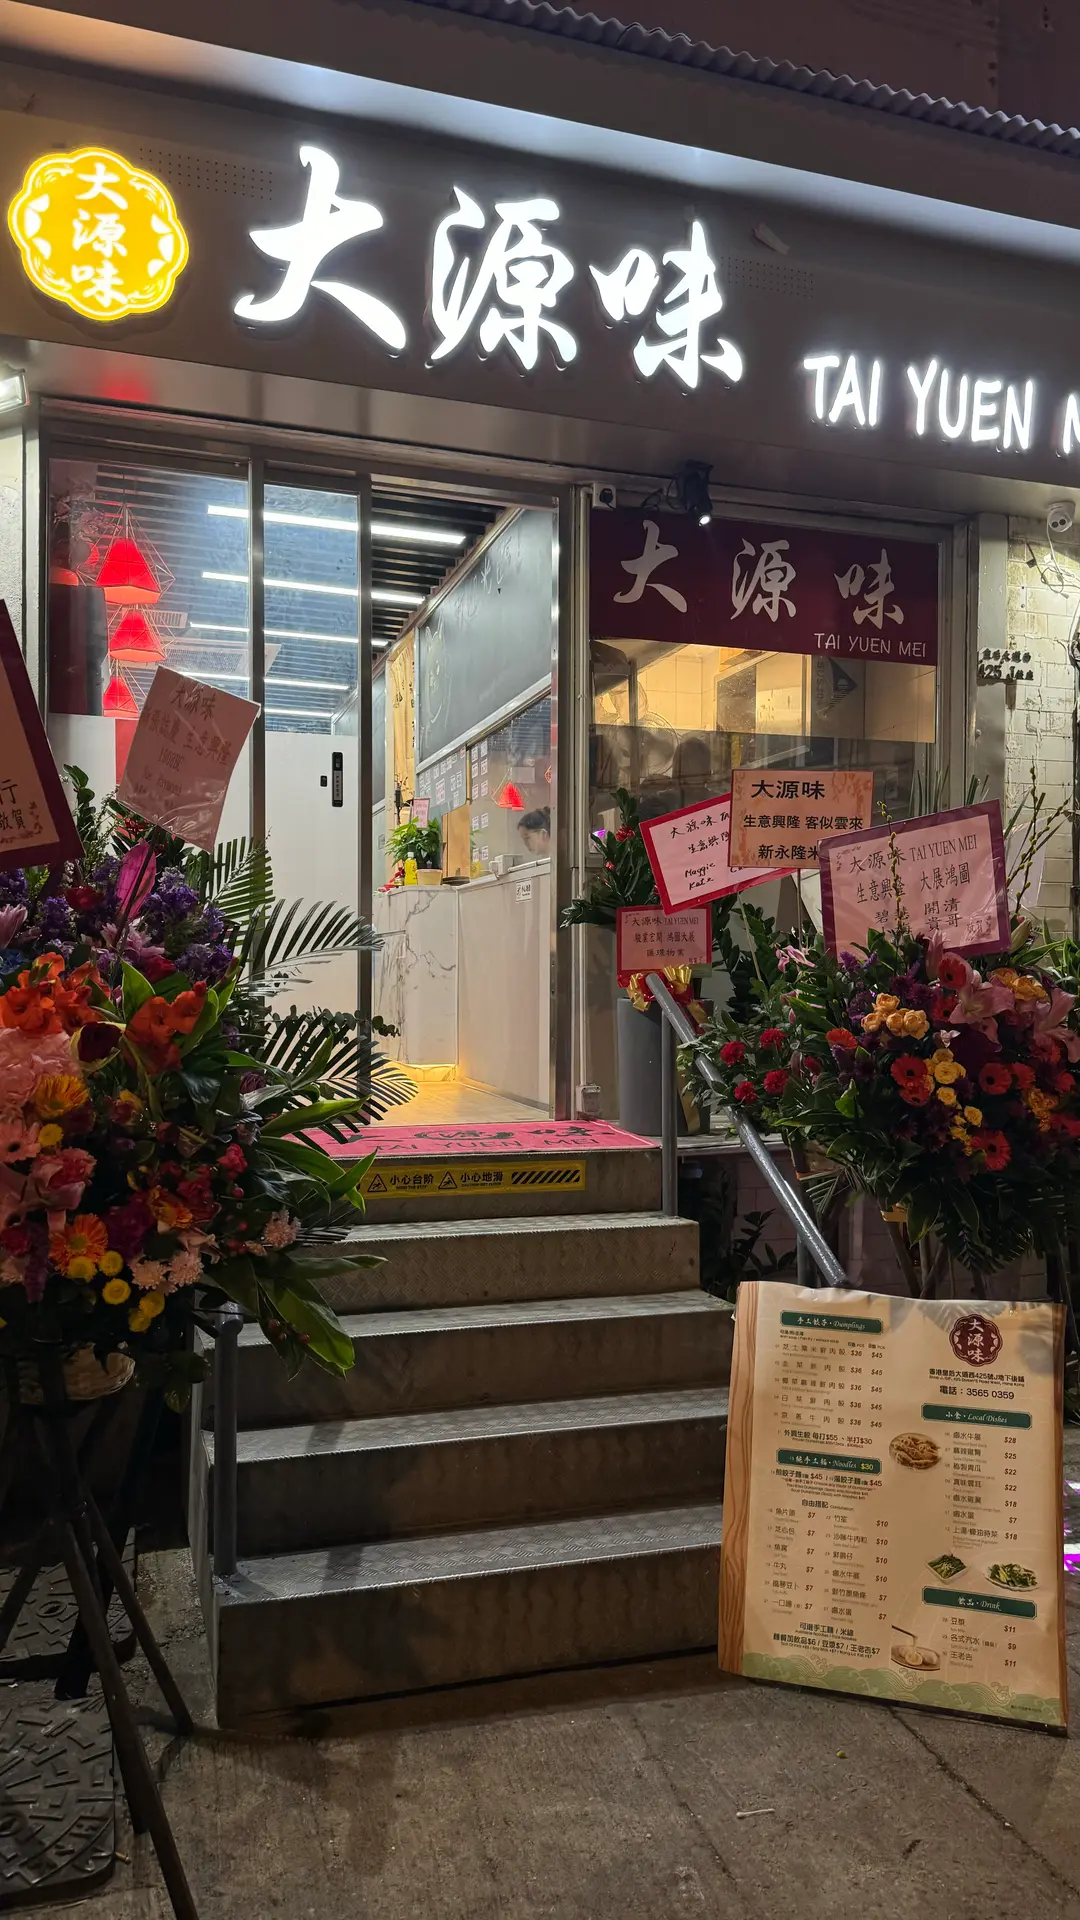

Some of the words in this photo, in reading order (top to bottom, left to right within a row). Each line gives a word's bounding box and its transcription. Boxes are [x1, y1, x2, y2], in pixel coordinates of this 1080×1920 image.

[72, 163, 128, 306] 大源味
[233, 145, 743, 389] 大源味
[803, 356, 881, 427] TAI
[906, 359, 1034, 450] YUEN
[613, 520, 904, 629] 大源味
[814, 633, 840, 649] TAI
[849, 636, 890, 653] YUEN
[899, 641, 926, 657] MEI
[751, 780, 825, 800] 大源味
[670, 815, 718, 839] 大源味
[743, 815, 800, 829] 生意興隆
[805, 816, 863, 830] 客似雲來
[849, 847, 906, 874] 大源味
[909, 847, 927, 862] TAI
[927, 841, 957, 859] YUEN
[958, 835, 977, 851] MEI
[685, 863, 715, 878] Maggie
[920, 862, 970, 892] 大展鴻圖
[632, 916, 662, 926] 大源味
[439, 1140, 523, 1149] YUEN
[543, 1138, 600, 1146] MEI
[390, 1173, 434, 1186] 小心台阶
[460, 1171, 503, 1183] 小心地滑
[833, 1320, 866, 1330] Dumplings
[968, 1319, 984, 1362] 大源味
[966, 1388, 989, 1398] 3565
[991, 1390, 1014, 1400] 0359
[967, 1413, 986, 1421] Local
[986, 1415, 1008, 1423] Dishes
[1004, 1436, 1017, 1444] $28
[1004, 1452, 1017, 1460] $25
[833, 1460, 857, 1469] Noodles
[980, 1600, 1002, 1611] Drink
[1004, 1625, 1016, 1633] $11
[951, 1634, 980, 1645] 各式汽水
[951, 1651, 973, 1661] 王老吉
